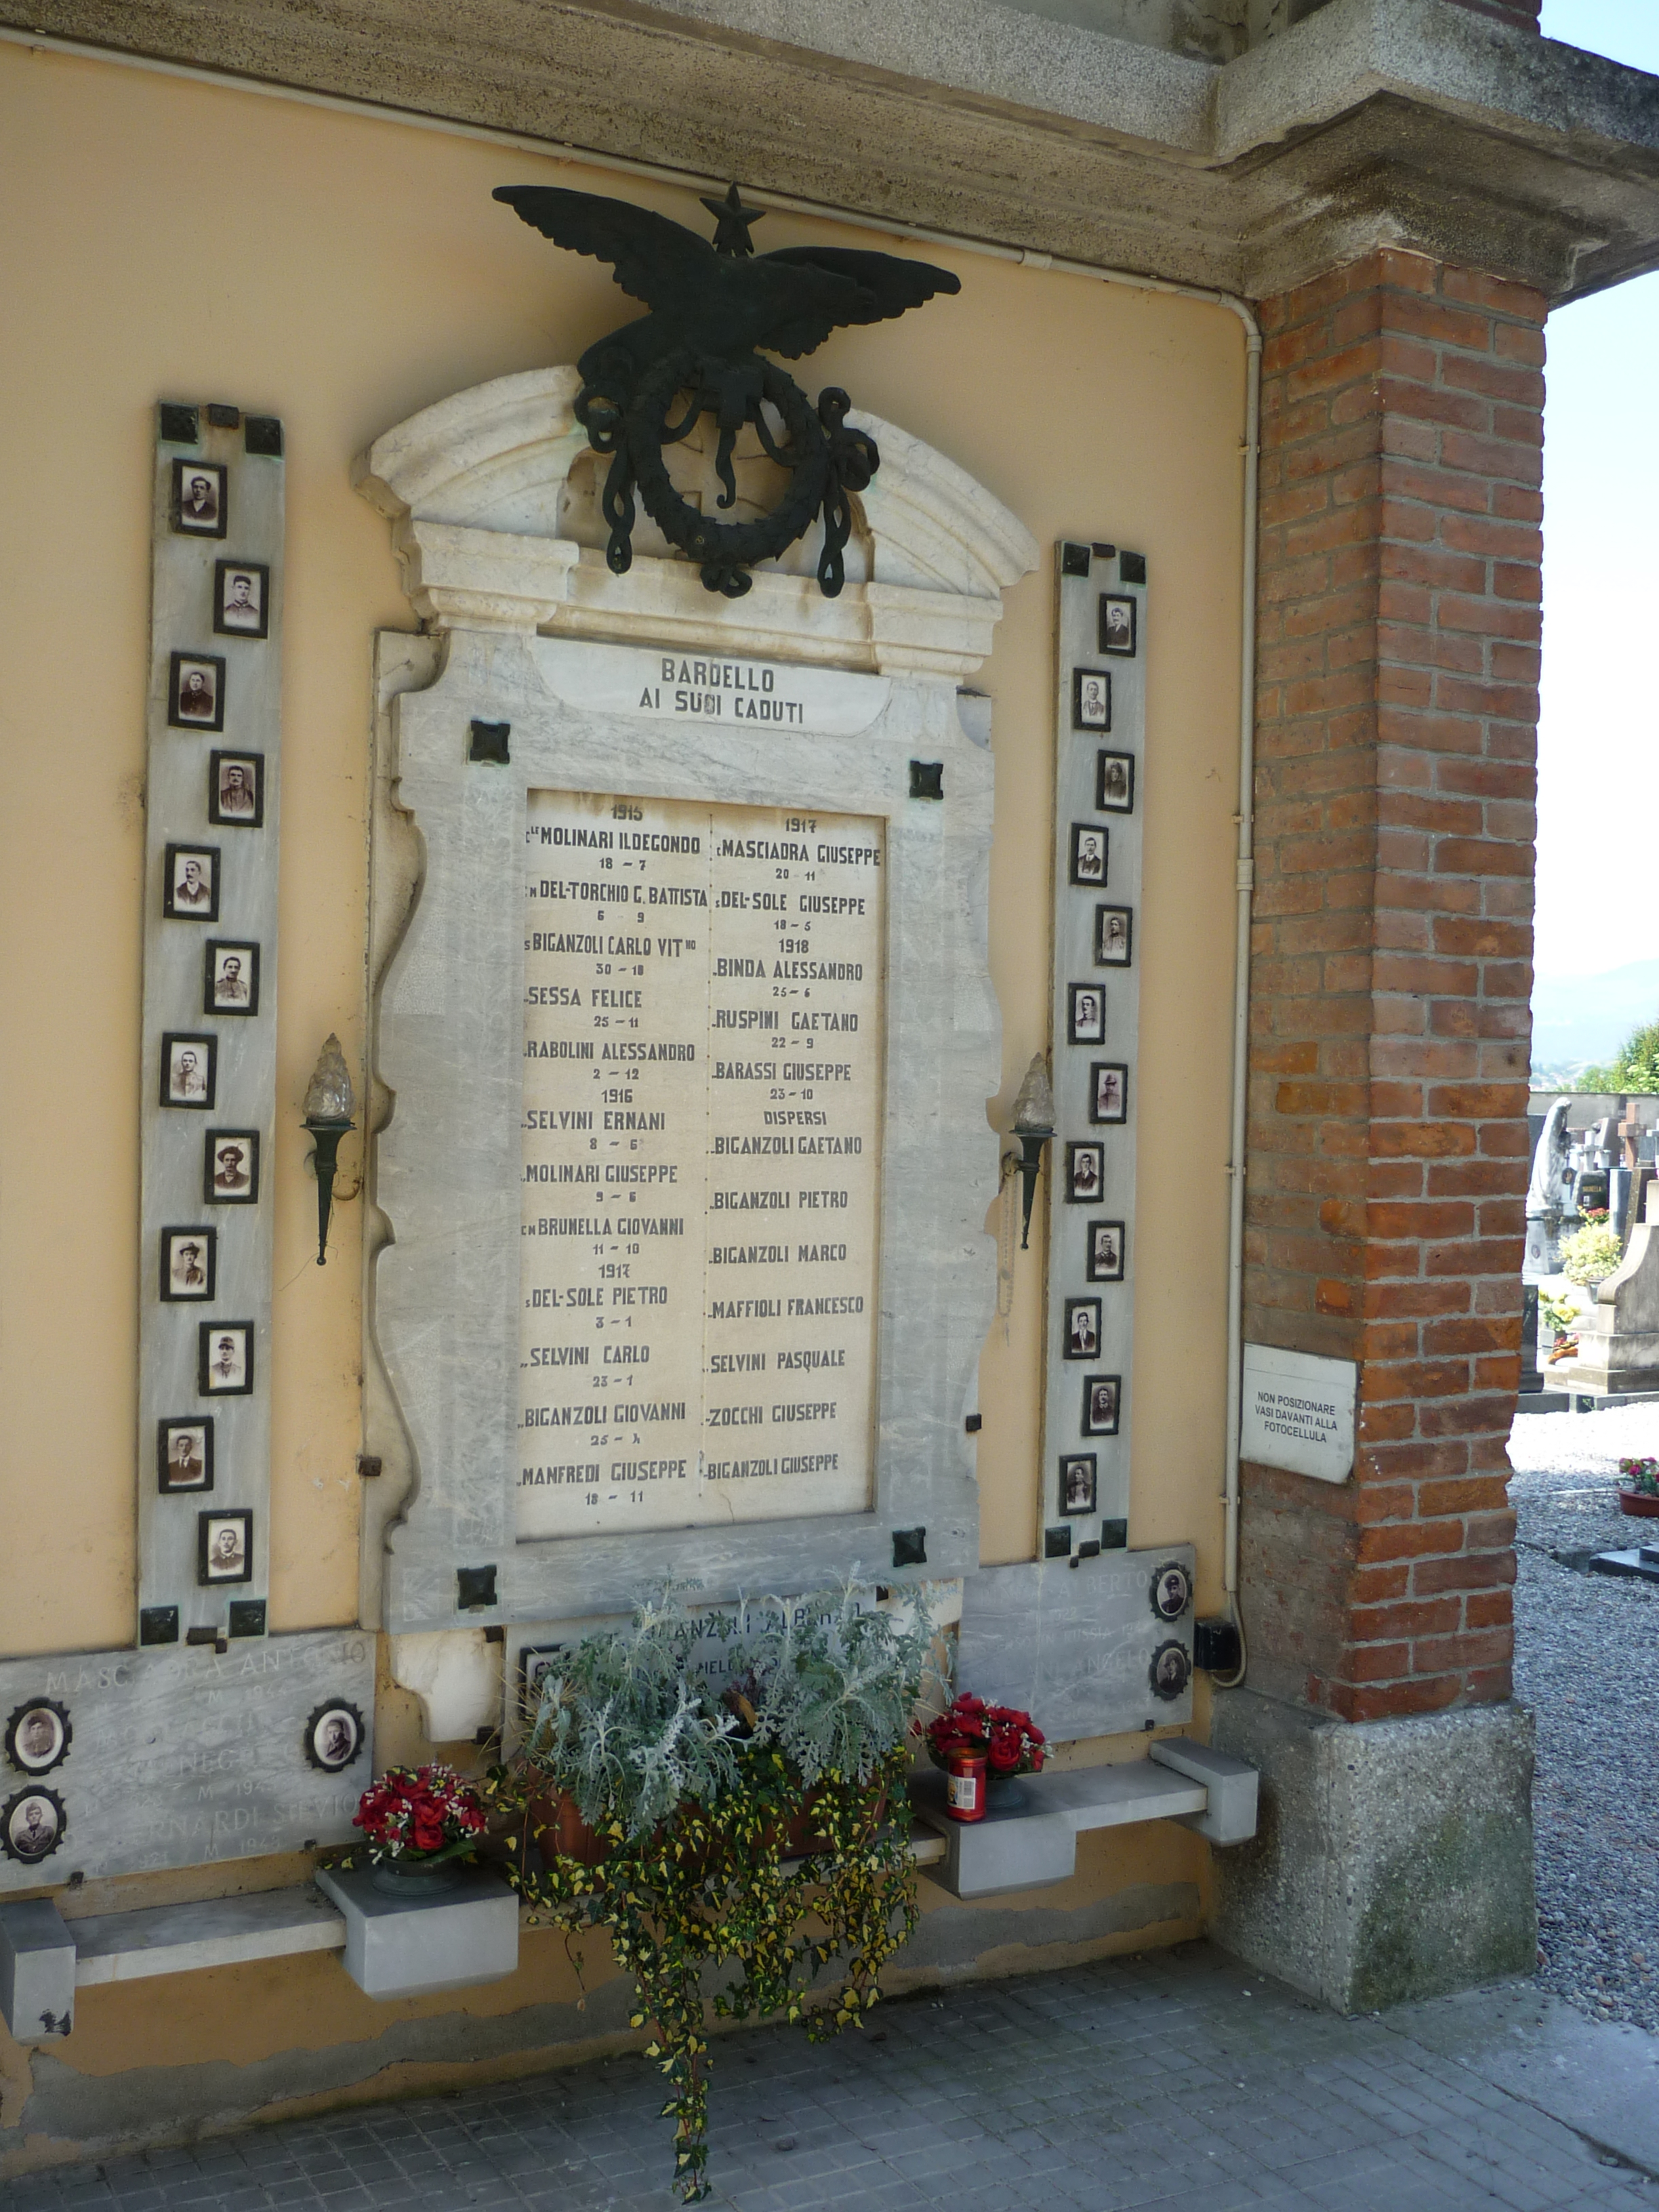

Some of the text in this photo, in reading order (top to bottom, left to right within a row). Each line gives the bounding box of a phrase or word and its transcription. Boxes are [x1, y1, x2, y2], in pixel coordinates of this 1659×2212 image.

[661, 657, 775, 693] BARDELLO
[640, 687, 802, 723] AI SUOI CADUTI
[611, 803, 642, 821] 1915
[785, 817, 817, 833] 1917
[541, 827, 613, 848] MOLINARI
[619, 832, 700, 854] ILDEGONDO
[717, 840, 881, 866] C MASCIADRA GIUSEPPE
[600, 857, 613, 869] 18
[639, 860, 646, 871] 7
[776, 868, 789, 879] 20
[805, 872, 815, 881] 11
[649, 887, 708, 907] BATTISTA
[716, 900, 720, 908] S
[800, 895, 865, 915] GIUSEPPE
[598, 910, 604, 920] 6
[638, 912, 644, 923] 9
[774, 920, 786, 930] 18
[804, 921, 811, 931] 5
[525, 940, 530, 950] S
[533, 933, 602, 954] BIGANZOLI
[609, 936, 651, 956] CARLO
[779, 939, 808, 954] 1918
[596, 963, 611, 975] 30
[716, 958, 862, 981] BINDA ALESSANDRO
[527, 987, 642, 1008] SESSA FELICE
[773, 986, 787, 997] 25
[804, 988, 810, 998] 6
[594, 1016, 609, 1027] 25
[629, 1017, 638, 1027] 11
[714, 1010, 858, 1031] RUSPINI GAETANO
[526, 1041, 695, 1061] RABOLINI ALESSANDRO
[772, 1037, 785, 1048] 22
[806, 1038, 813, 1048] 9
[593, 1069, 600, 1079] 2
[625, 1068, 639, 1080] 12
[714, 1062, 851, 1081] BARASSI GIUSEPPE
[602, 1089, 632, 1103] 1916
[770, 1088, 785, 1100] 23
[801, 1088, 813, 1100] 10
[526, 1111, 664, 1130] SELVINI ERNANI
[764, 1111, 826, 1125] DISPERSI
[590, 1138, 597, 1149] 8
[630, 1139, 637, 1150] 6
[714, 1136, 861, 1154] BIGANZOLI GAETANO
[527, 1164, 677, 1183] MOLINARI GIUSEPPE
[596, 1191, 603, 1202] 9
[630, 1191, 636, 1202] 6
[713, 1191, 848, 1209] BIGANZOLI PIETRO
[539, 1218, 612, 1235] BRUNELLA
[617, 1218, 683, 1235] GIOVANNI
[593, 1244, 603, 1254] 11
[626, 1243, 639, 1254] 10
[712, 1244, 846, 1264] BIGANZOLI MARCO
[598, 1264, 630, 1278] 1917
[526, 1299, 530, 1308] S
[613, 1286, 668, 1305] PIETRO
[712, 1296, 863, 1319] MAFFIOLI FRANCESCO
[596, 1317, 604, 1328] 3
[626, 1316, 631, 1327] 1
[531, 1345, 649, 1367] SELVINI CARLO
[711, 1350, 845, 1373] SELVINI PASQUALE
[593, 1376, 608, 1387] 23
[627, 1374, 633, 1386] 1
[1258, 1391, 1335, 1416] NON POSIZIONARE
[525, 1402, 685, 1427] BIGANZOLI GIOVANNI
[709, 1402, 836, 1427] ZOCCHI GIUSEPPE
[1255, 1404, 1338, 1431] VASI DAVANTI ALLA
[591, 1435, 609, 1446] 25
[1264, 1421, 1327, 1443] FOTOCELLULA
[523, 1460, 687, 1486] MANFREDI GIUSEPPE
[706, 1454, 838, 1480] BIGANZOLI GIUSEPPE
[586, 1492, 598, 1505] 18
[631, 1491, 642, 1502] 11
